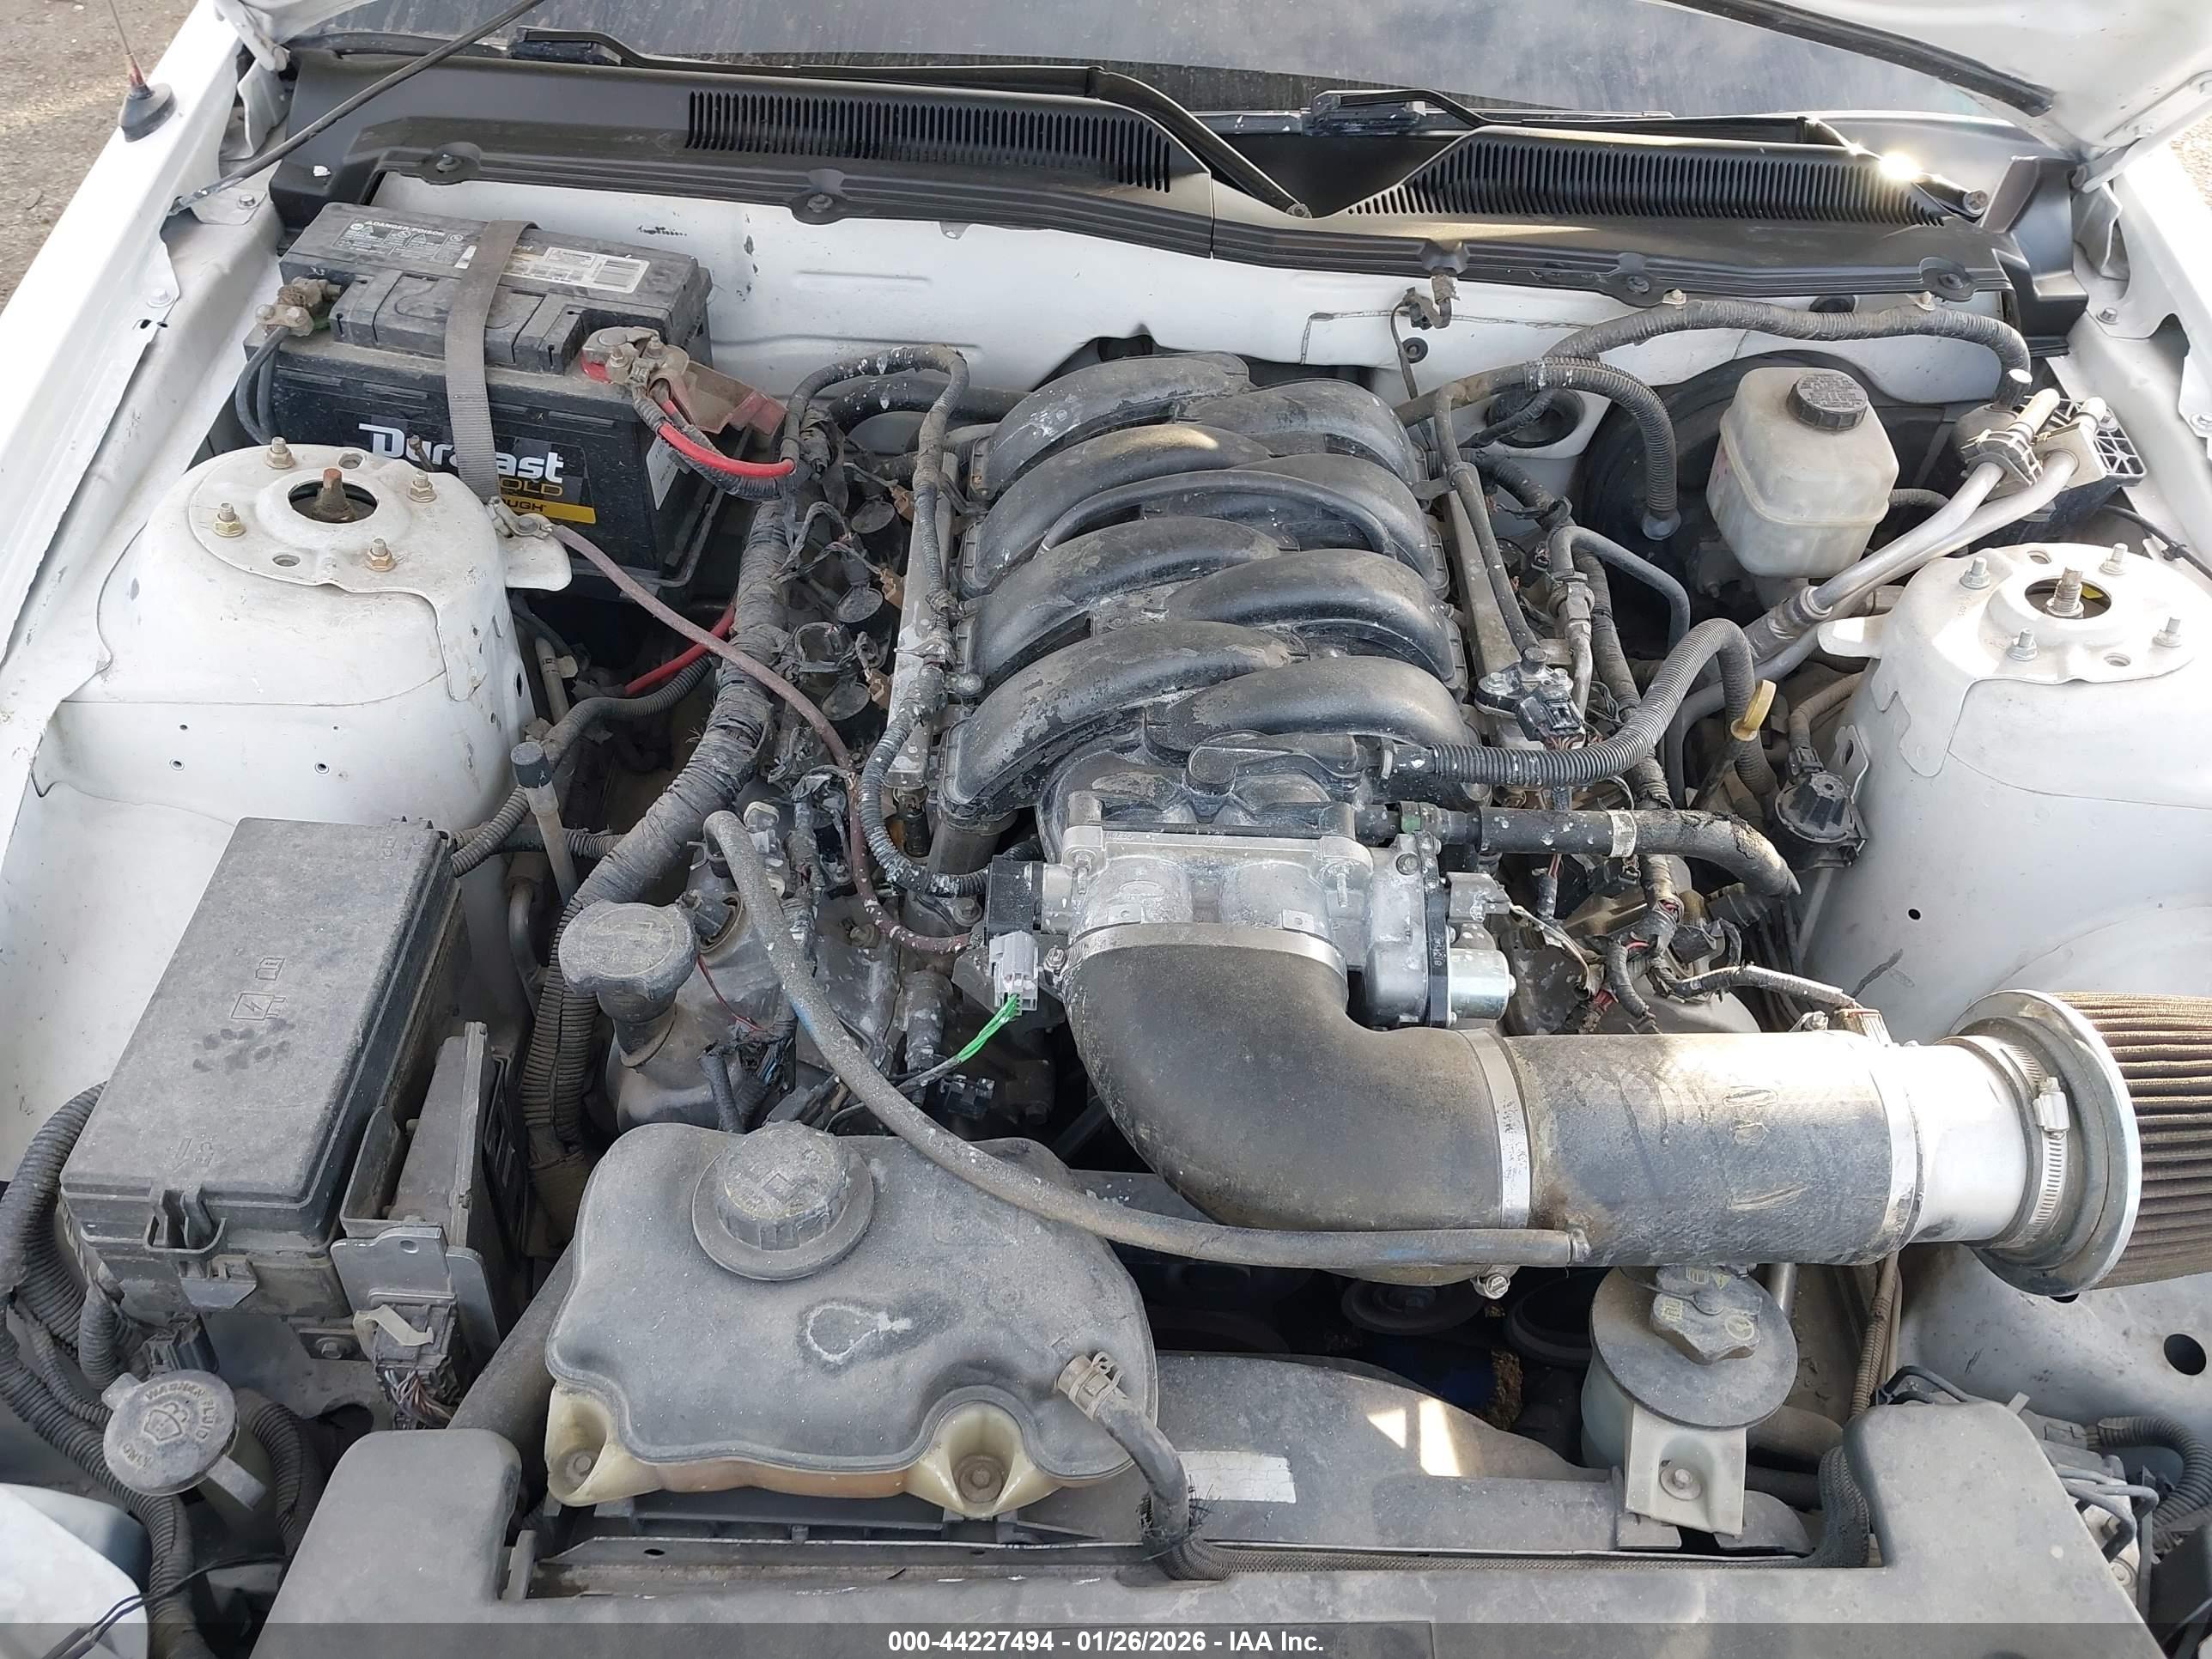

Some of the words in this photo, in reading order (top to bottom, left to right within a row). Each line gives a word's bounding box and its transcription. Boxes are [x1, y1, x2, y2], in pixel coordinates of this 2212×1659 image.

[358, 422, 564, 483] Durast
[499, 477, 563, 496] OLD
[501, 498, 544, 513] UGH
[196, 1400, 215, 1439] FLUID
